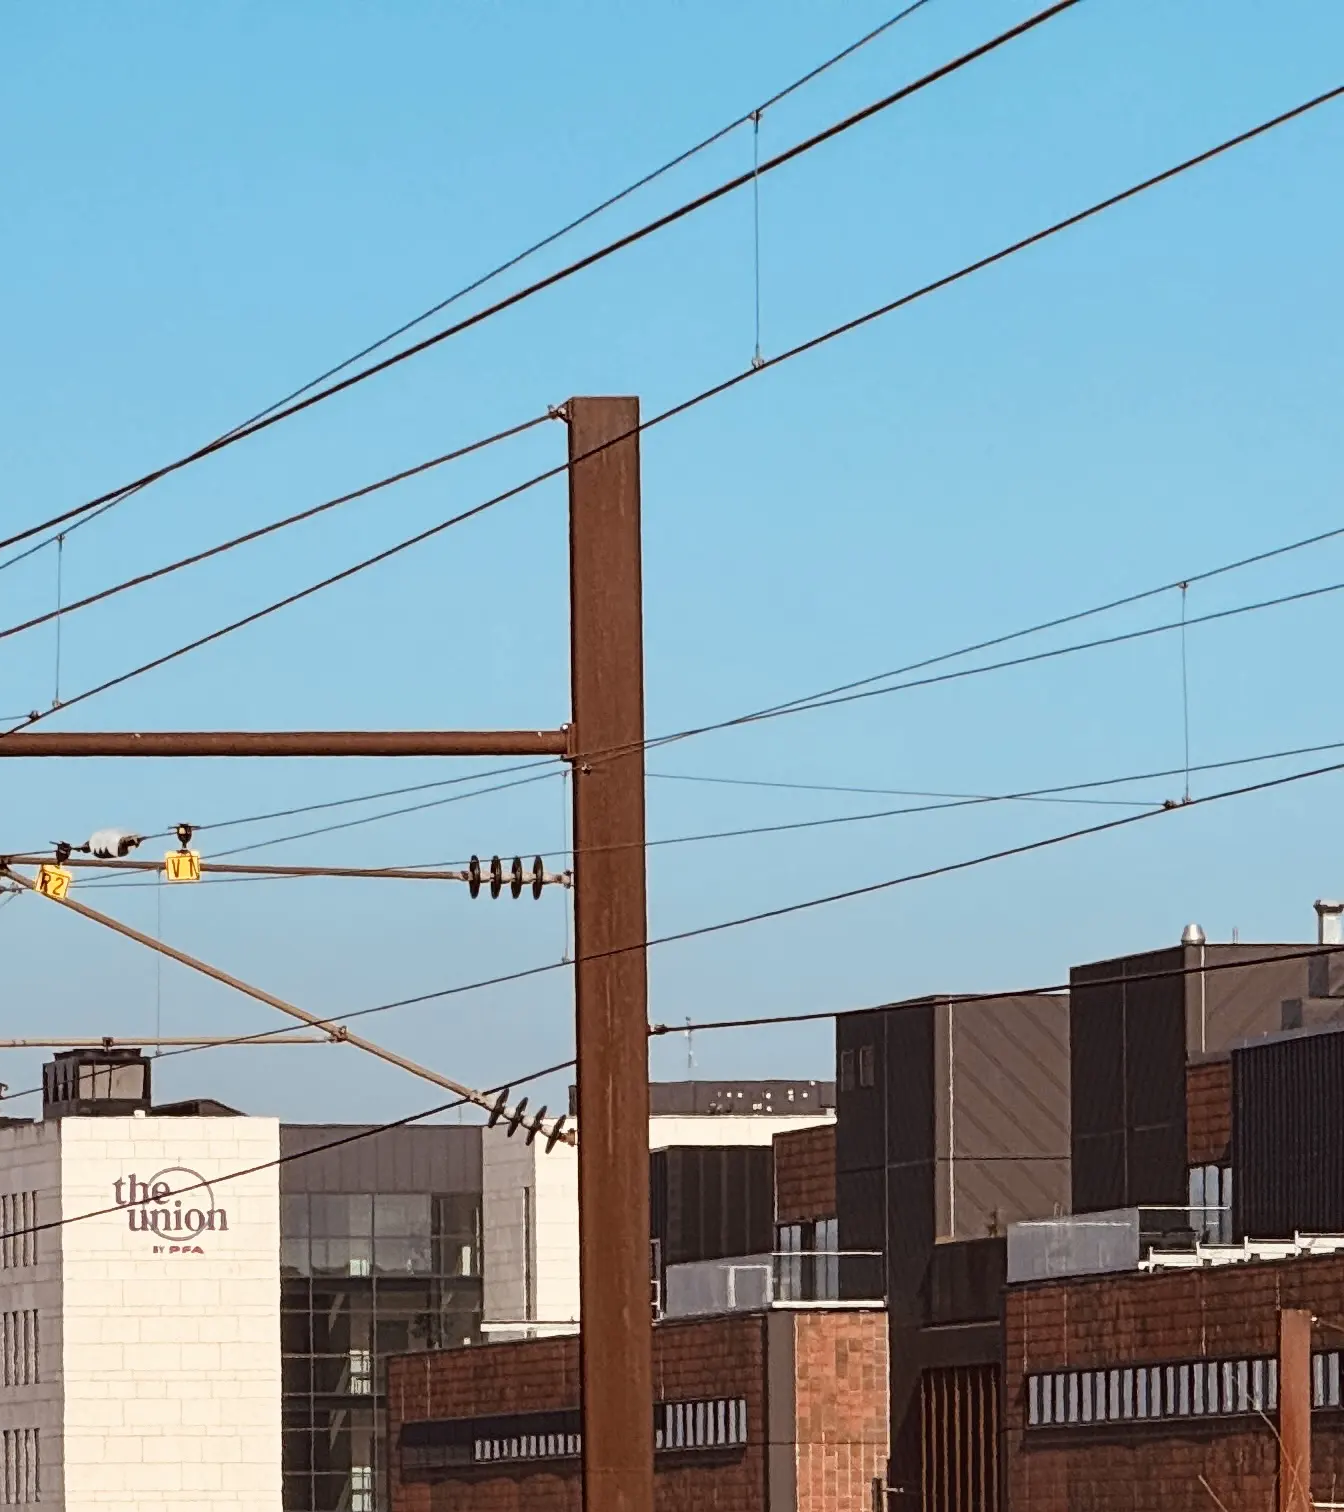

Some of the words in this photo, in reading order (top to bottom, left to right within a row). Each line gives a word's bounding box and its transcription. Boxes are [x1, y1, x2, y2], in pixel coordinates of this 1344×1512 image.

[112, 1173, 171, 1205] the
[127, 1200, 229, 1232] union
[169, 1245, 204, 1254] PFA
